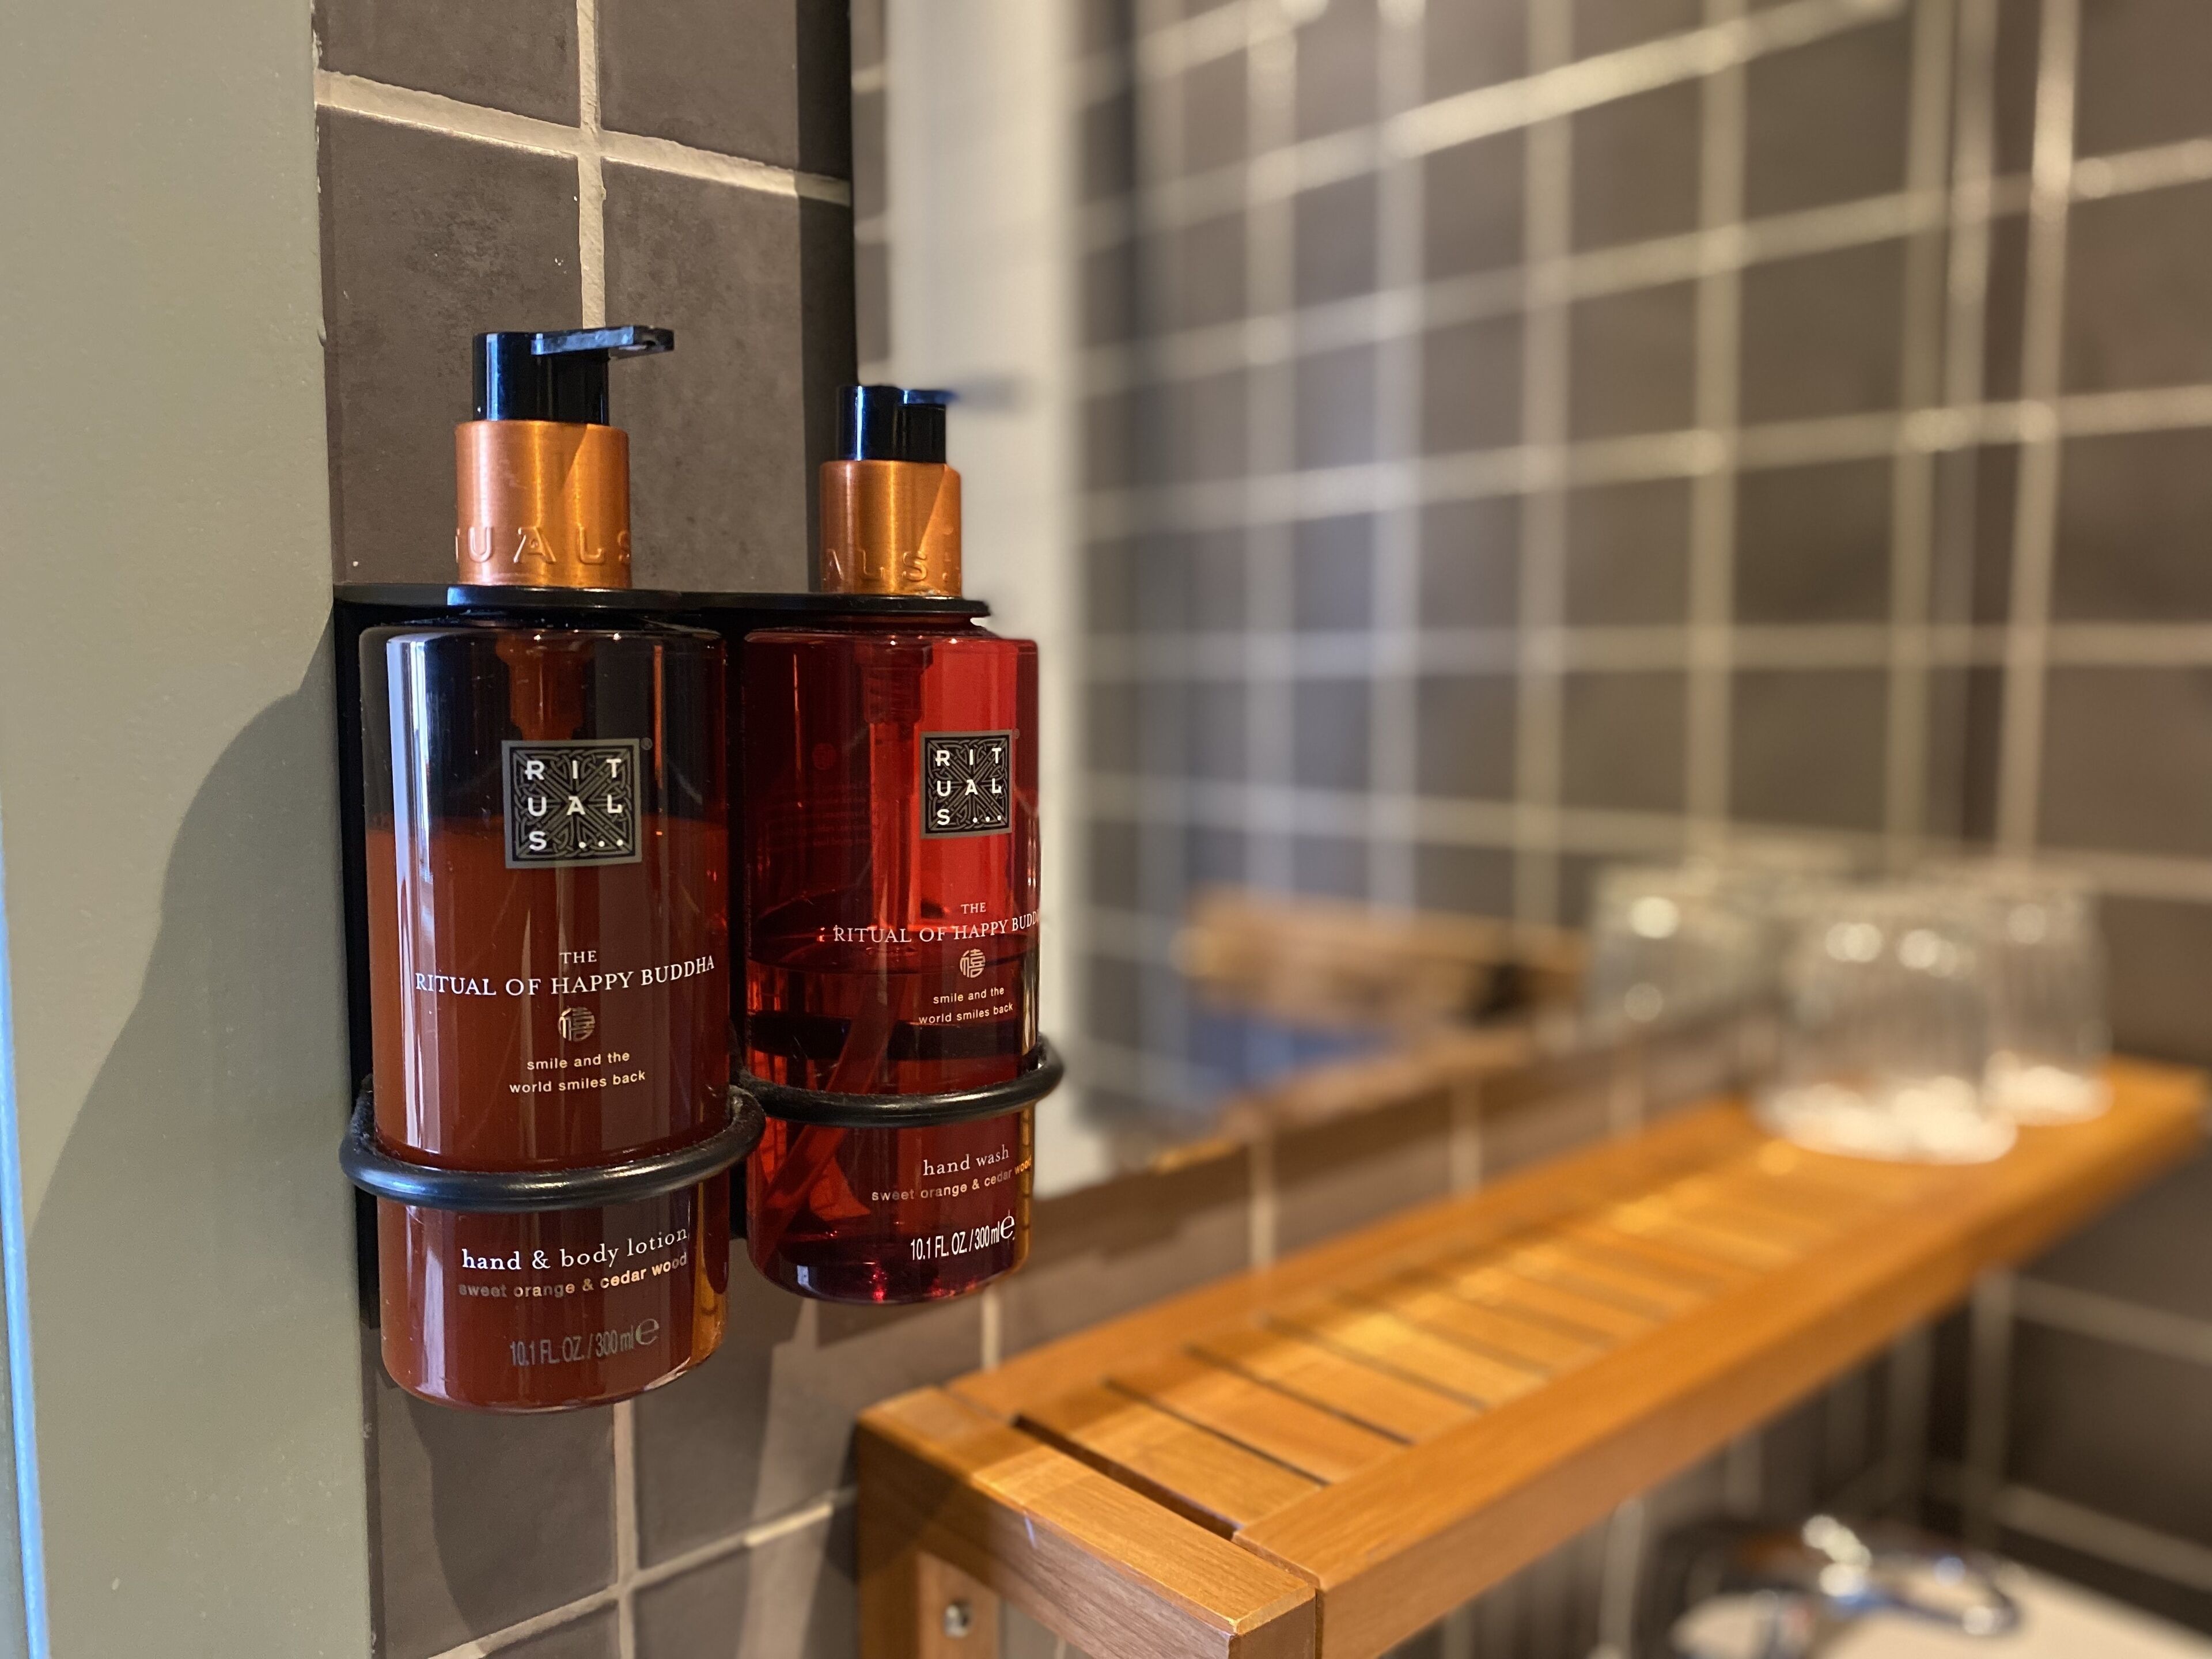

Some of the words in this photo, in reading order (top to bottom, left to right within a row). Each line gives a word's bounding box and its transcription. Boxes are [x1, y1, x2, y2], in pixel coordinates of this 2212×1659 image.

[960, 902, 986, 914] THE
[834, 926, 912, 943] RITUAL
[919, 927, 947, 942] OF
[953, 919, 1008, 941] HAPPY
[1012, 910, 1038, 931] BUDD
[559, 950, 597, 964] THE
[415, 972, 497, 995] RITUAL
[506, 979, 541, 995] OF
[551, 971, 634, 995] HAPPY
[641, 955, 715, 986] BUDDHA
[933, 991, 964, 1004] smile
[968, 988, 987, 999] and
[990, 986, 1005, 997] the
[918, 1013, 952, 1024] world
[956, 1008, 990, 1021] smiles
[993, 1002, 1013, 1015] back
[527, 1056, 567, 1070] smile
[574, 1053, 601, 1067] and
[607, 1051, 630, 1064] the
[509, 1081, 552, 1093] world
[558, 1077, 607, 1092] smiles
[613, 1070, 646, 1086] back
[923, 1153, 970, 1176] hand
[976, 1144, 1009, 1166] wash
[872, 1188, 914, 1201] sweet
[921, 1184, 967, 1197] orange
[972, 1178, 980, 1190] &
[984, 1169, 1012, 1187] cedar
[1014, 1154, 1032, 1175] wood
[461, 1248, 521, 1270] hand
[532, 1249, 551, 1269] &
[559, 1243, 619, 1268] body
[627, 1228, 688, 1256] lotion
[910, 1237, 931, 1261] 10.1
[459, 1284, 507, 1298] sweet
[513, 1283, 575, 1298] orange
[582, 1278, 594, 1291] &
[600, 1268, 646, 1289] cedar
[652, 1252, 687, 1277] wood
[510, 1340, 535, 1366] 10.1
